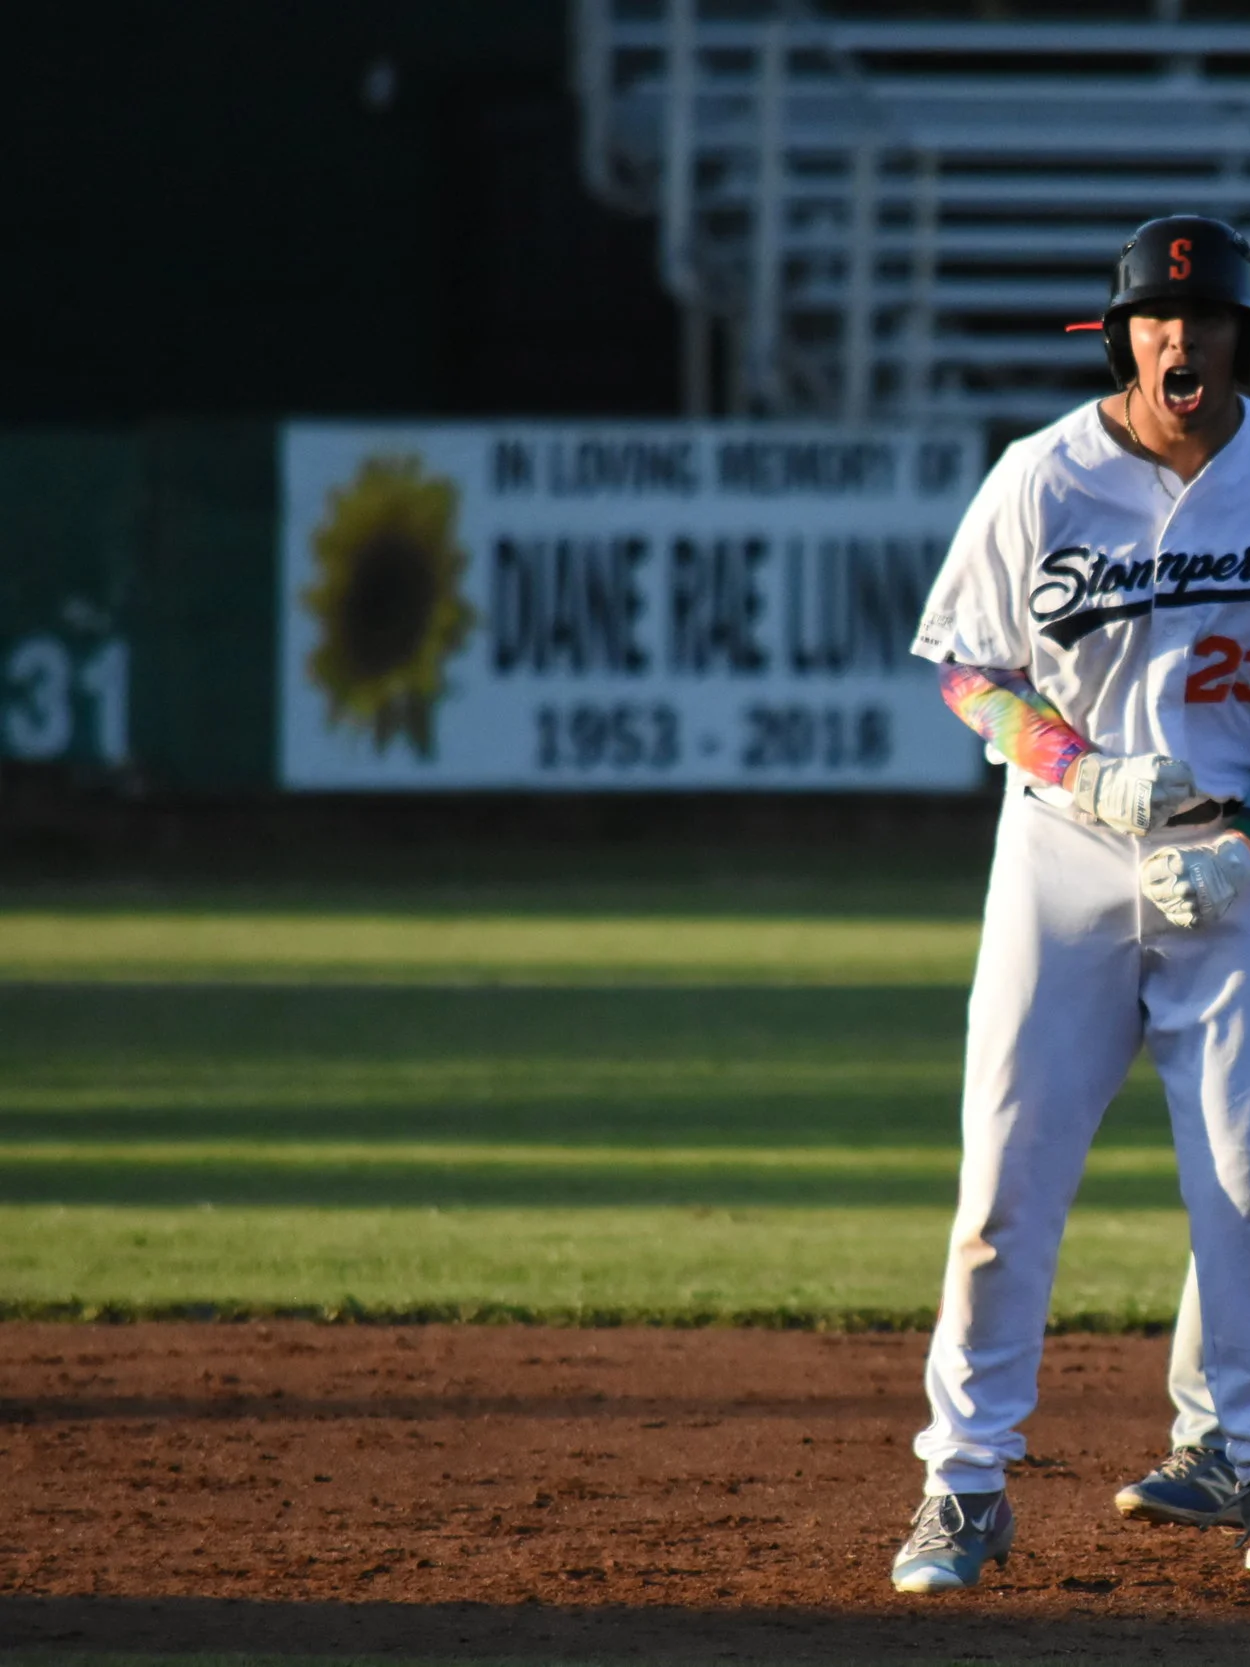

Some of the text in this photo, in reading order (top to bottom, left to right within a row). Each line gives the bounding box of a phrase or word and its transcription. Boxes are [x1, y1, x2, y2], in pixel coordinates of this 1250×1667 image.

[1169, 238, 1192, 281] S
[494, 440, 534, 495] IN
[549, 440, 699, 495] LOVING
[718, 440, 894, 495] MEMORY
[494, 534, 650, 677] DIANE
[671, 534, 770, 677] RAE
[5, 638, 129, 764] 31
[537, 704, 680, 769] 1953
